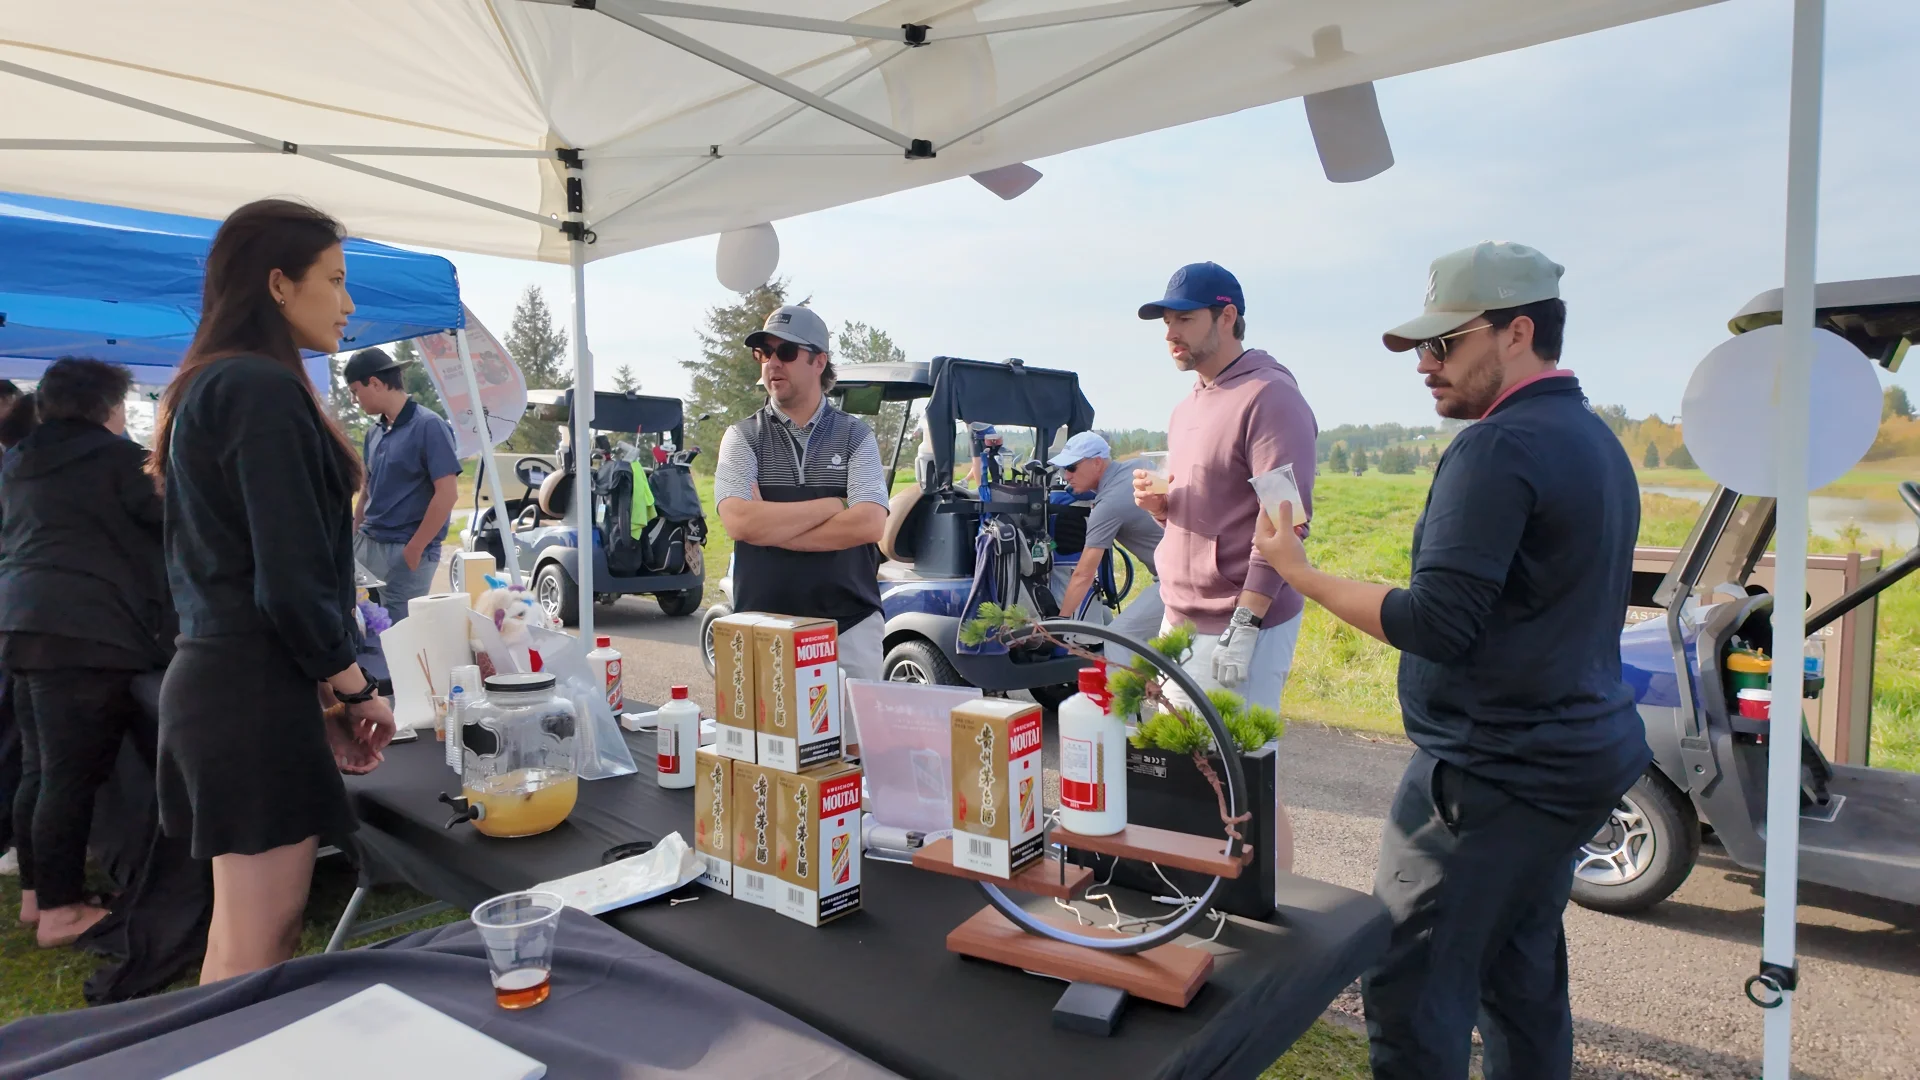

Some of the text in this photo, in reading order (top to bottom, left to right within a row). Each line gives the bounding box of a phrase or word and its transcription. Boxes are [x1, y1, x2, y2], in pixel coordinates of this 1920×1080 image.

[800, 634, 830, 644] KWEICHOW
[796, 640, 836, 662] MOUTAI
[1009, 726, 1041, 754] MOUTAI
[826, 782, 855, 794] KWEICHOW
[822, 787, 859, 813] MOUTAI
